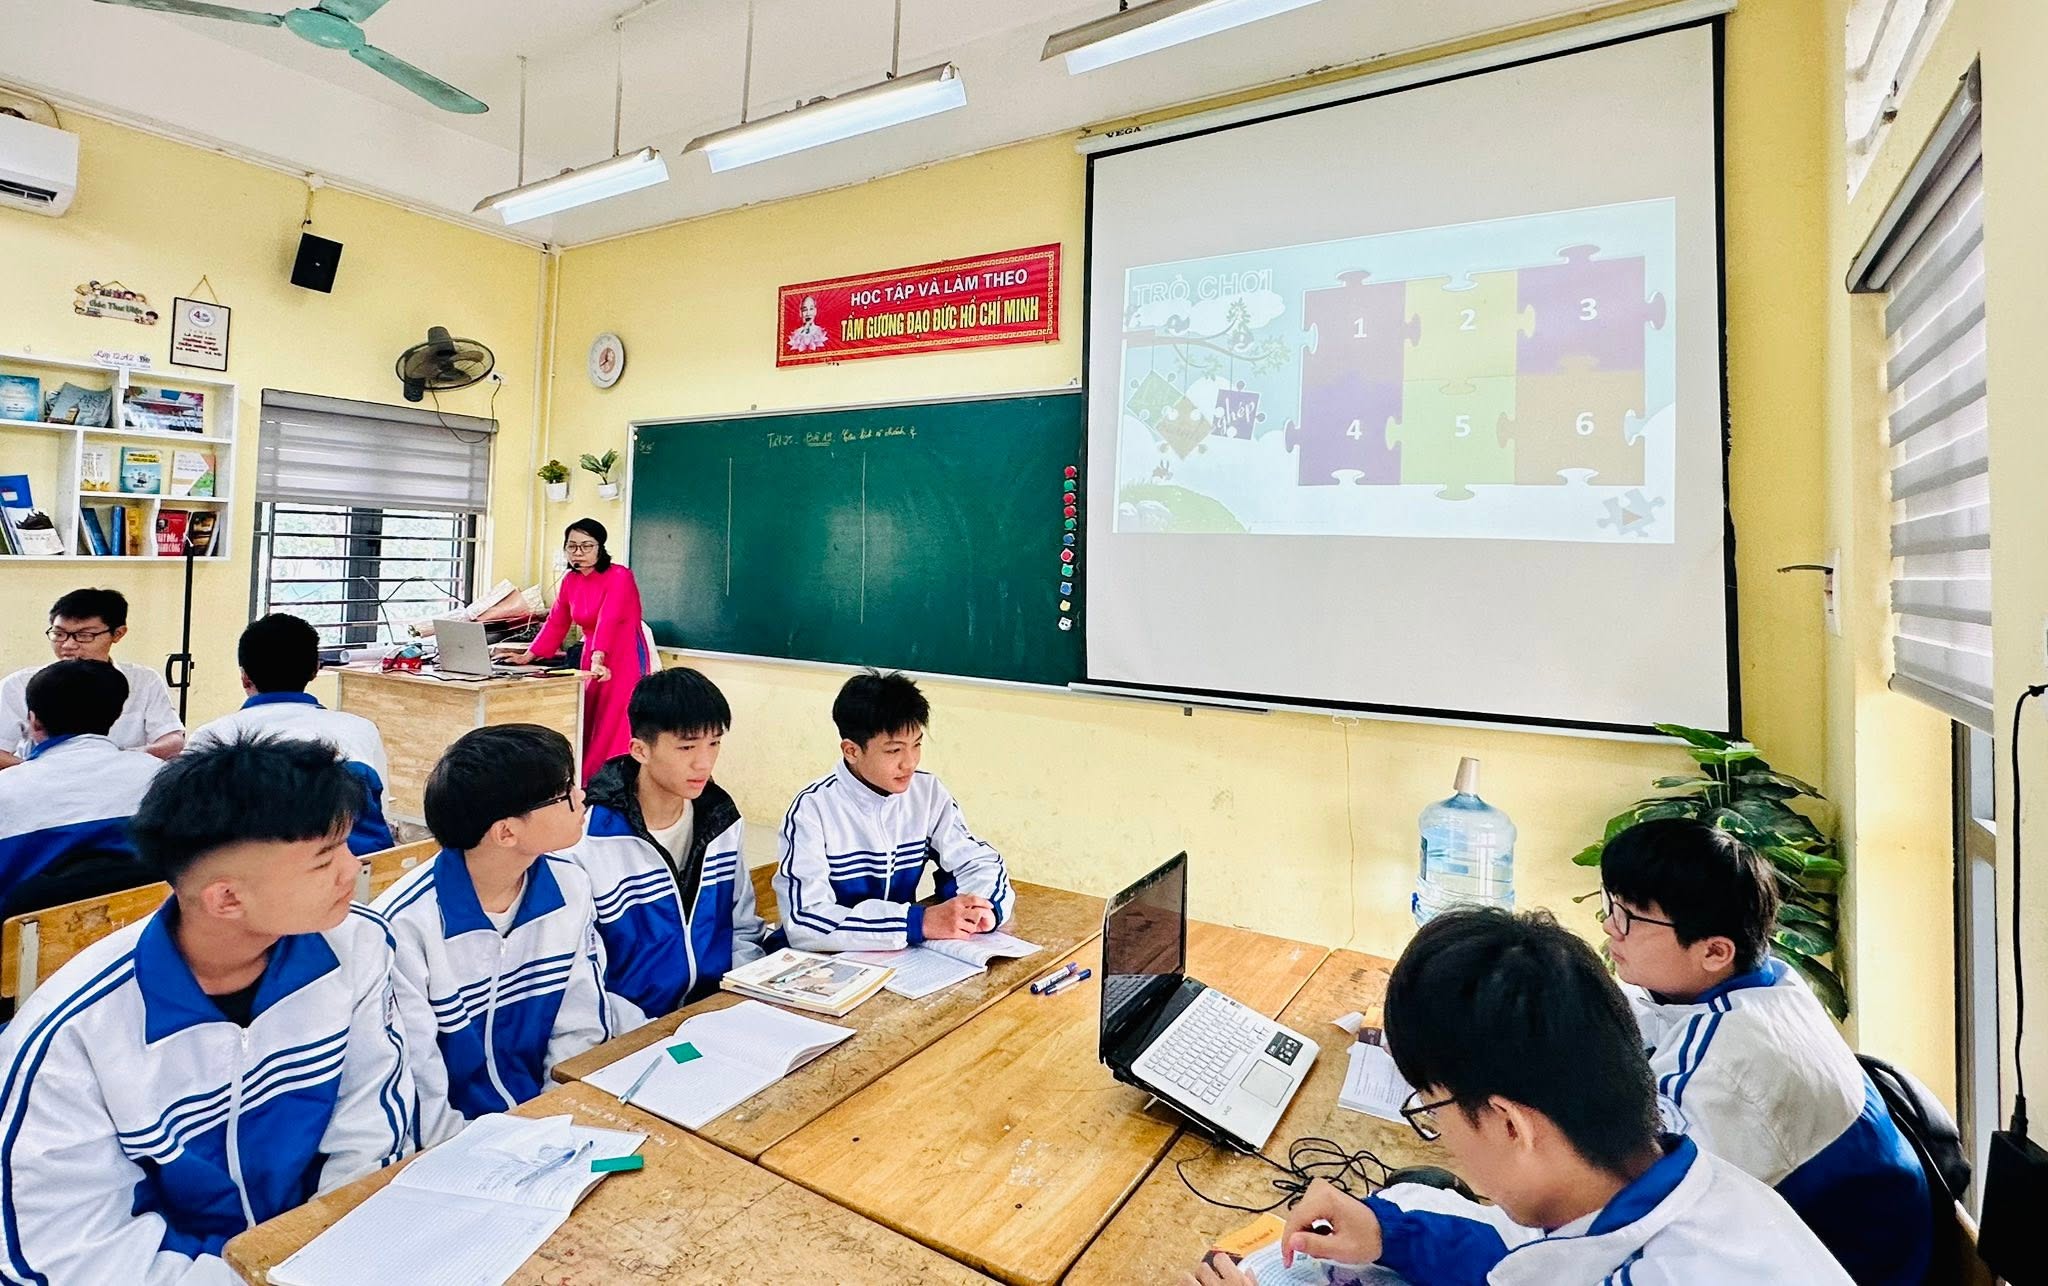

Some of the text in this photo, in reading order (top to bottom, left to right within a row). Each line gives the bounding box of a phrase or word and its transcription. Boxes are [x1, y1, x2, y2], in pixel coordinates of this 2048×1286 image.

[1105, 127, 1142, 138] VEGA
[851, 268, 1028, 310] HỌC TẬP VÀ LÀM THEO
[1133, 268, 1273, 306] TRÒ CHƠI
[841, 295, 1040, 342] TẤM GƯƠNG ĐẠO ĐỨC HỒ CHÍ MINH
[1459, 308, 1477, 331] 2
[1579, 297, 1599, 322] 3
[1353, 317, 1368, 339] 1
[1345, 419, 1363, 441] 4
[1454, 415, 1472, 438] 5
[1575, 411, 1595, 436] 6
